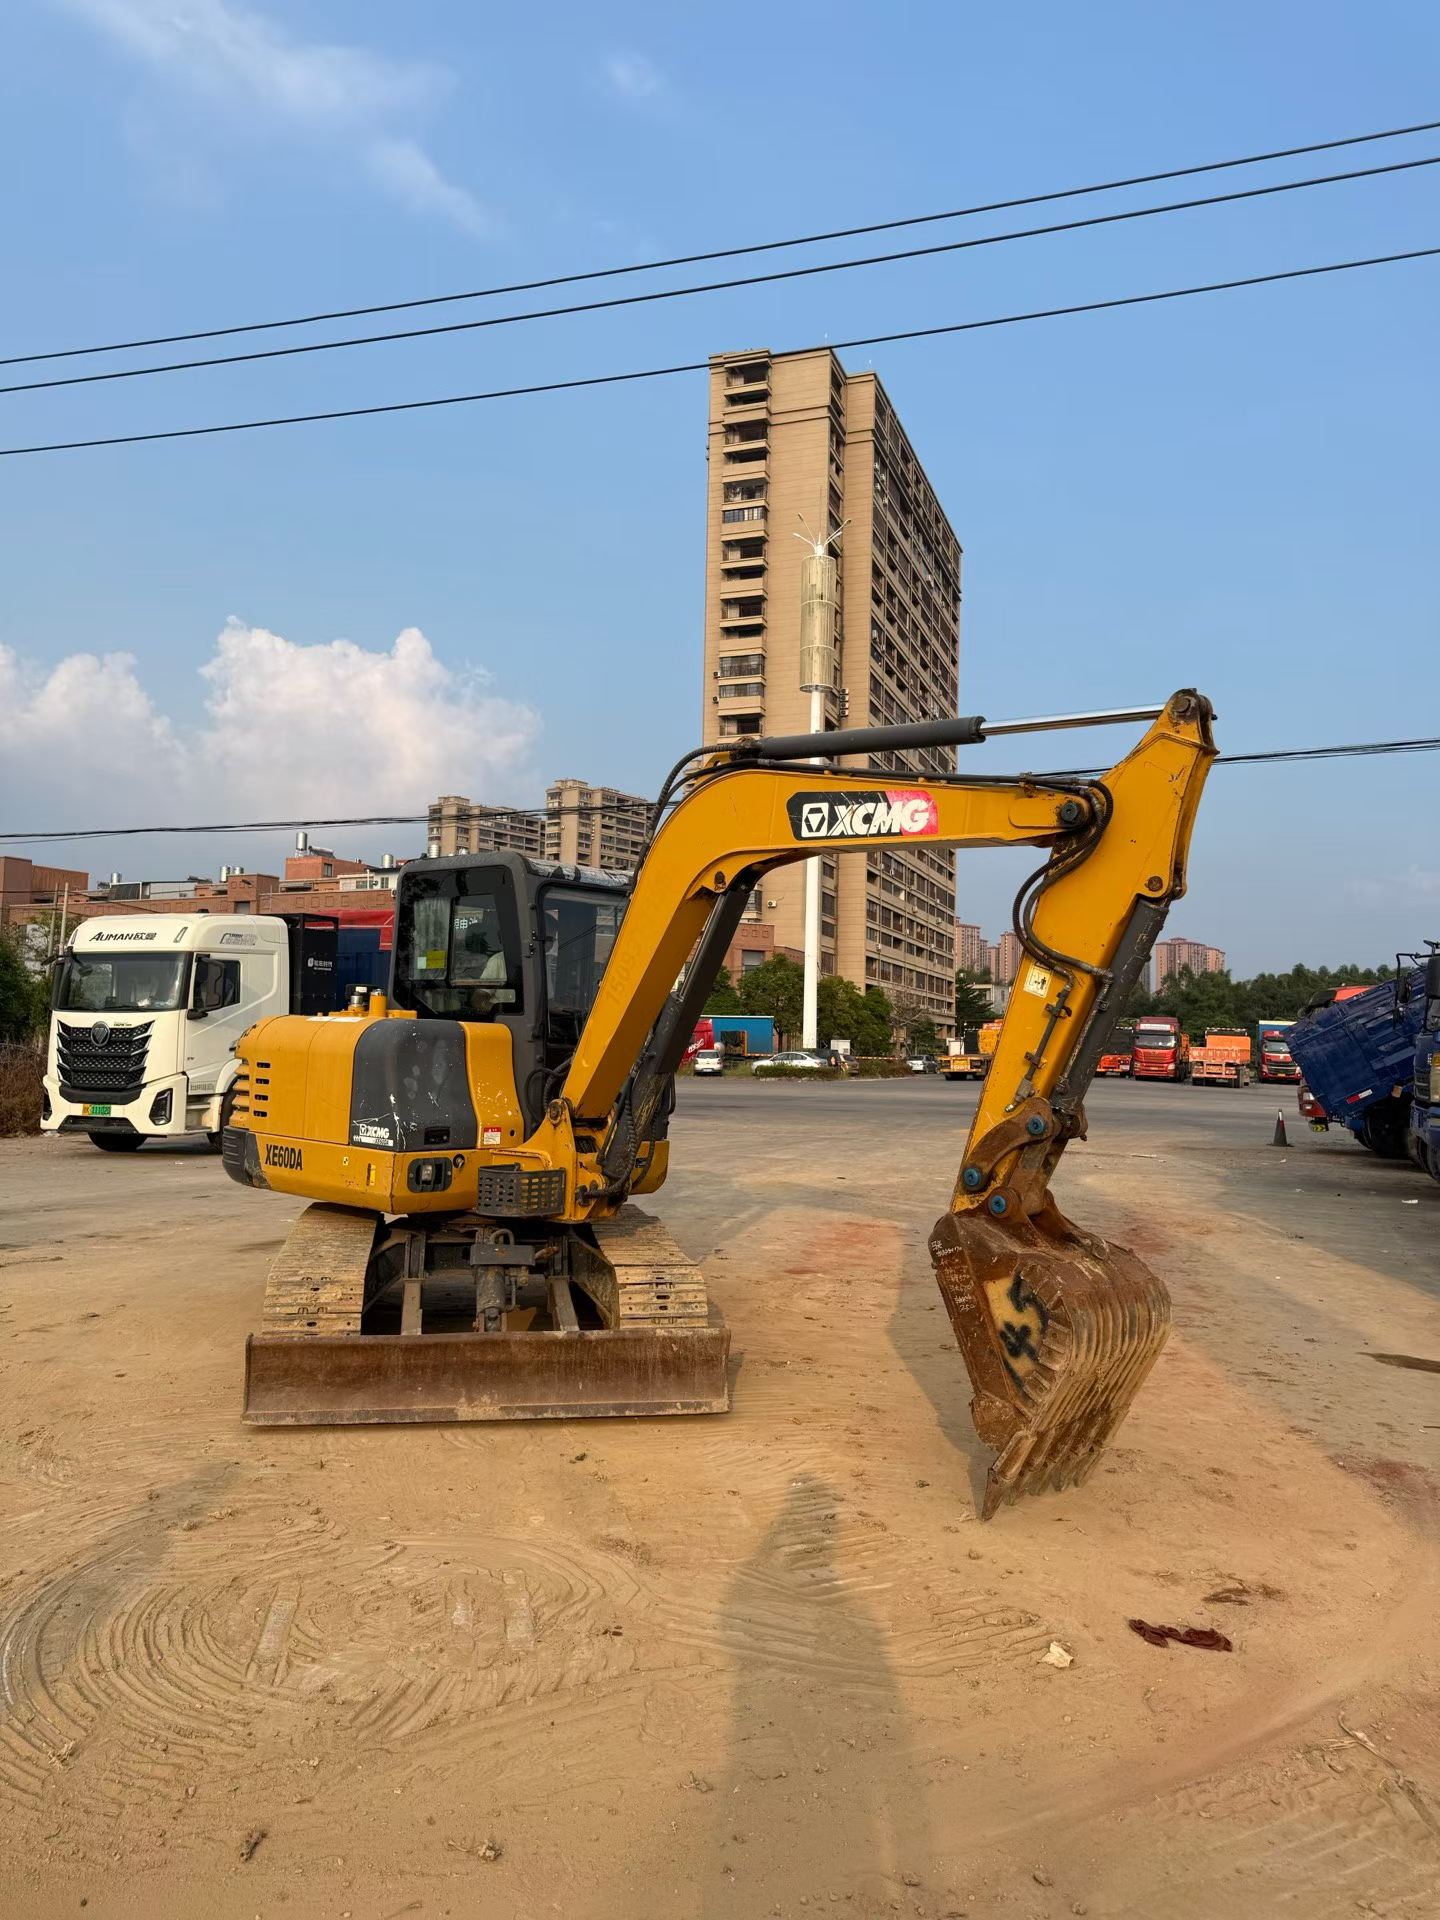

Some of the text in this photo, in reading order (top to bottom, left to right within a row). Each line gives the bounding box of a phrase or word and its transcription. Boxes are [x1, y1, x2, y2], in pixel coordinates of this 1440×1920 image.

[827, 799, 930, 836] XCMG
[366, 1125, 390, 1139] XCMG
[265, 1143, 303, 1171] XE60DA
